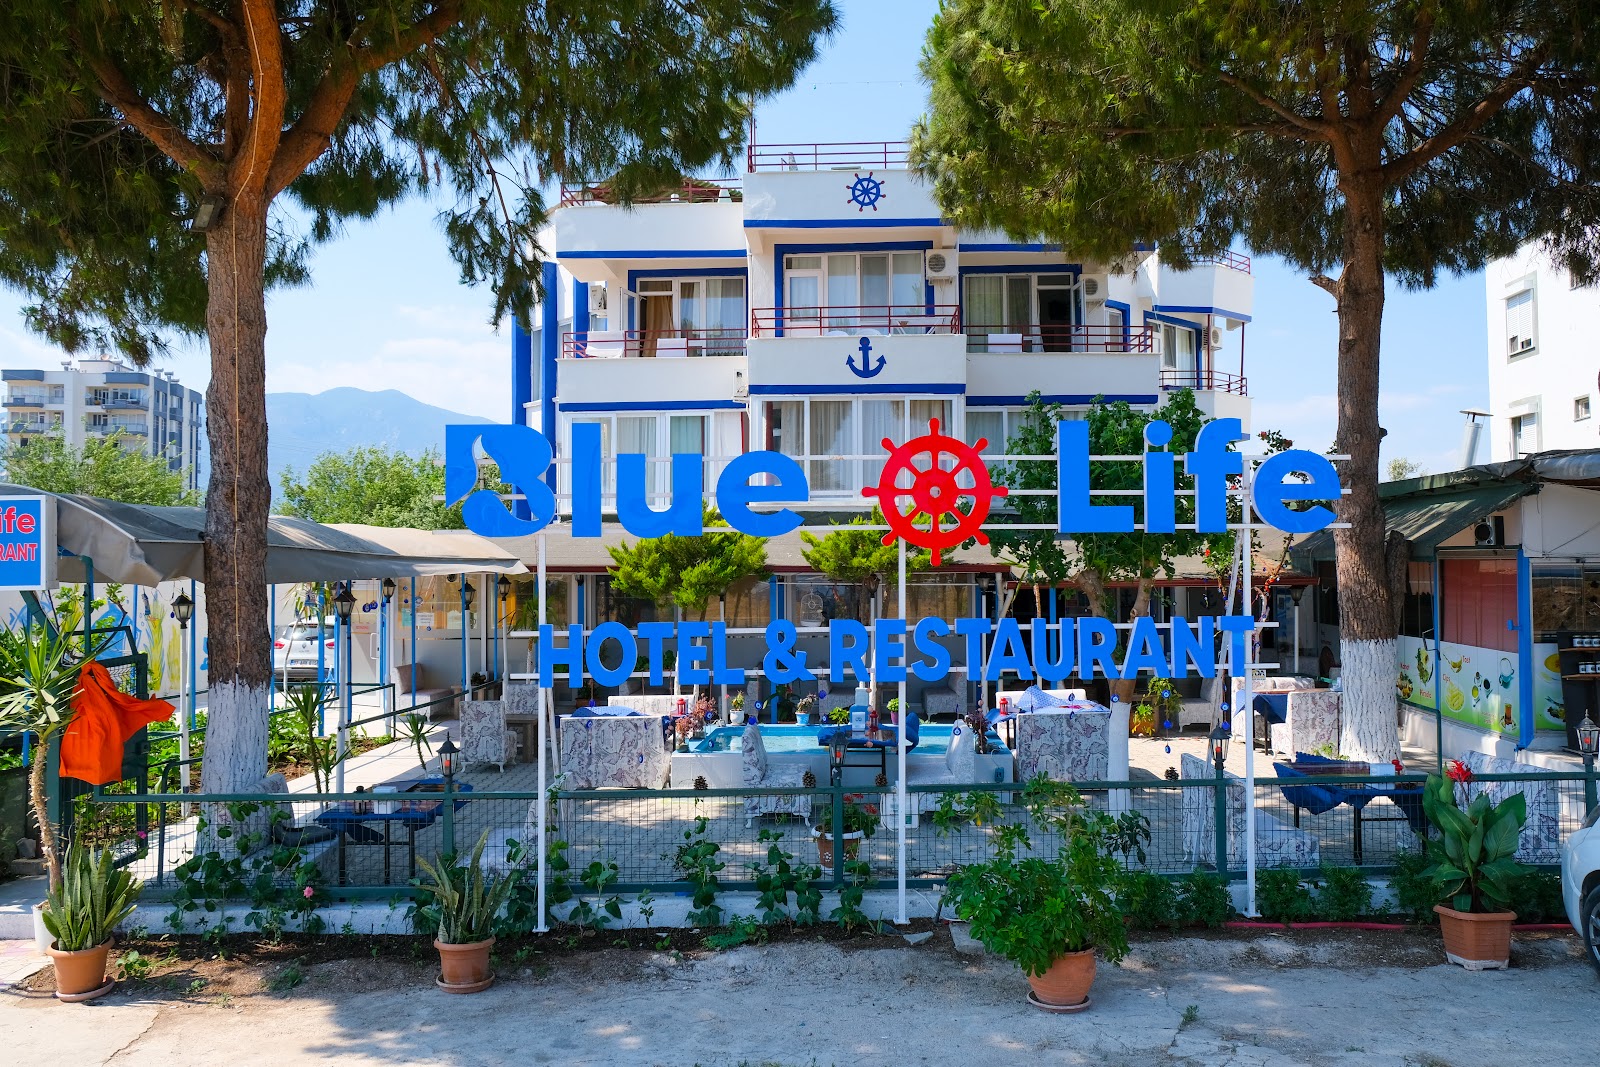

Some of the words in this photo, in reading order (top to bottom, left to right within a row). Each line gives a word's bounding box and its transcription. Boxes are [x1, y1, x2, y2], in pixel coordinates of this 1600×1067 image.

[446, 423, 809, 537] Blue
[1056, 418, 1342, 534] Life
[539, 621, 745, 689] HOTEL
[762, 619, 817, 685] &
[829, 615, 1255, 682] RESTAURANT
